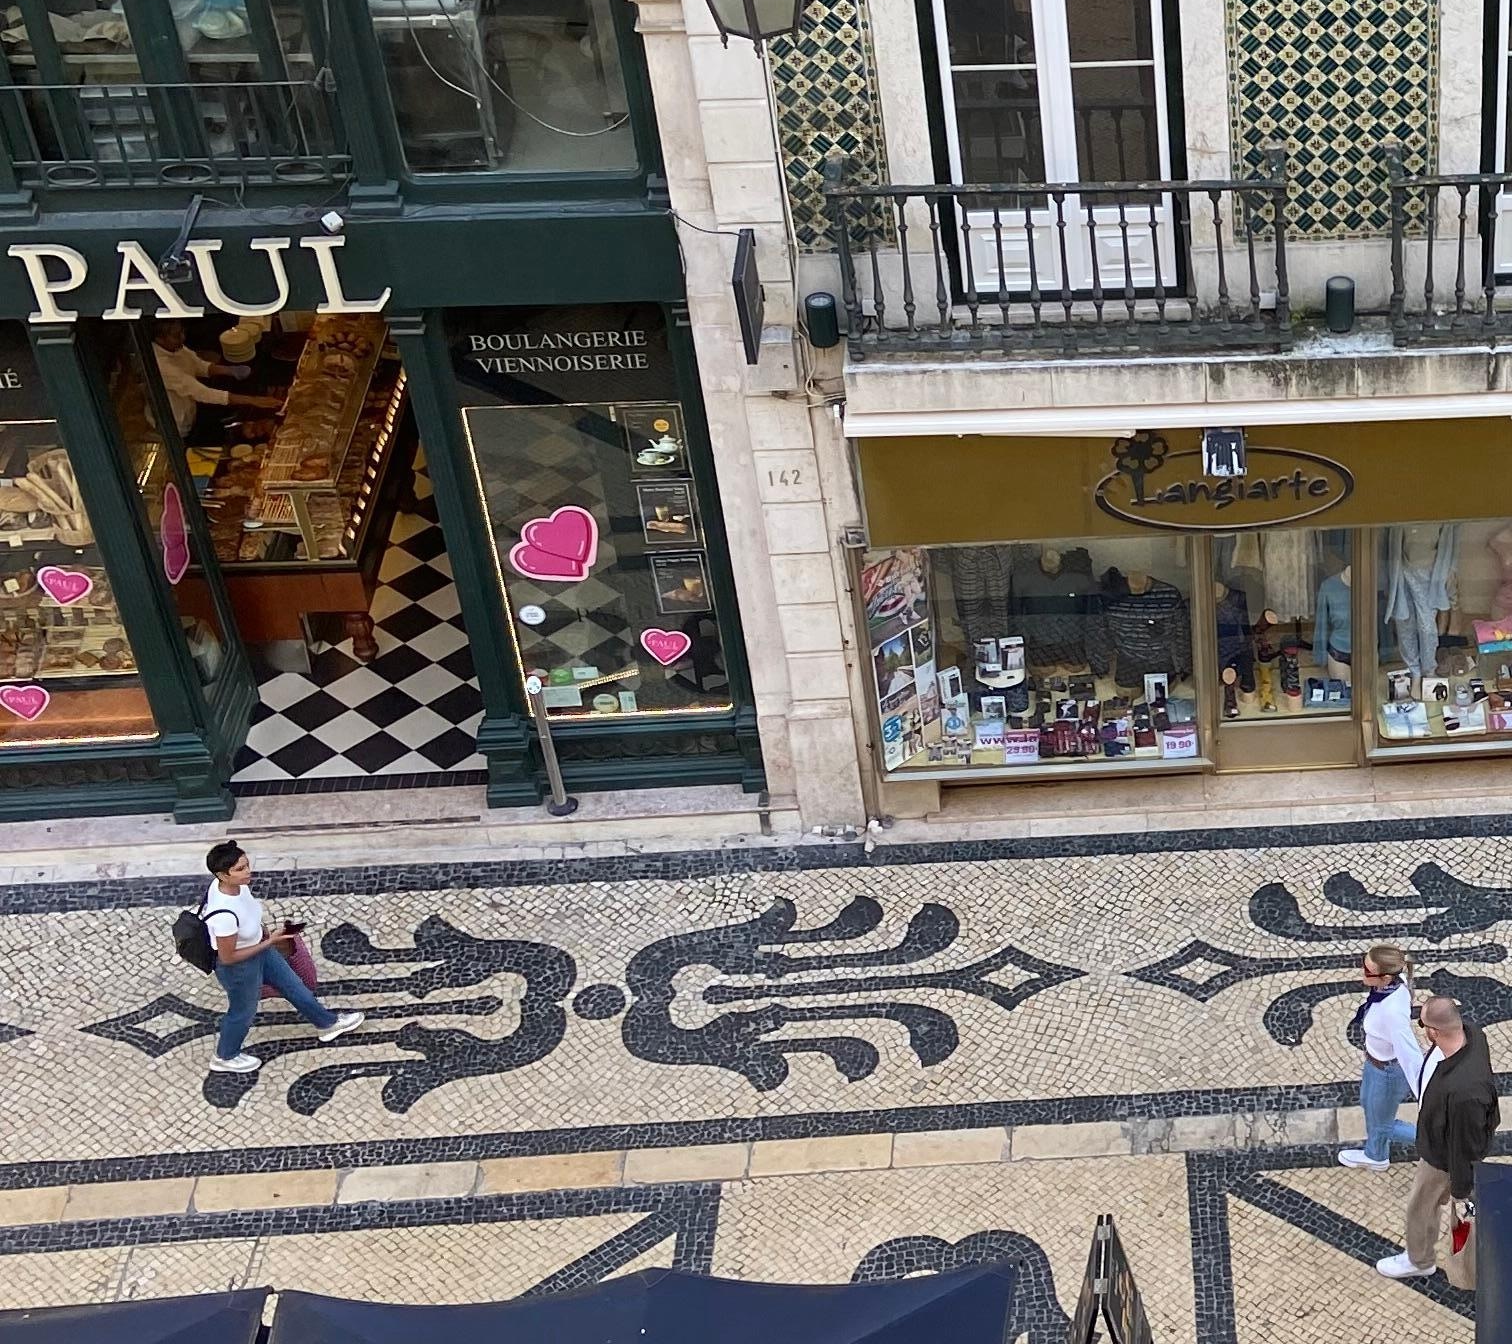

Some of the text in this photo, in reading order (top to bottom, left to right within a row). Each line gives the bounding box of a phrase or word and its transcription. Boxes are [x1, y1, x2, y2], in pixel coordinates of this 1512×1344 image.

[8, 236, 391, 323] PAUL
[469, 330, 648, 352] BOULANGERIE
[475, 353, 650, 374] VIENNOISERIE
[767, 469, 803, 487] 142
[1130, 459, 1330, 510] Langiarte
